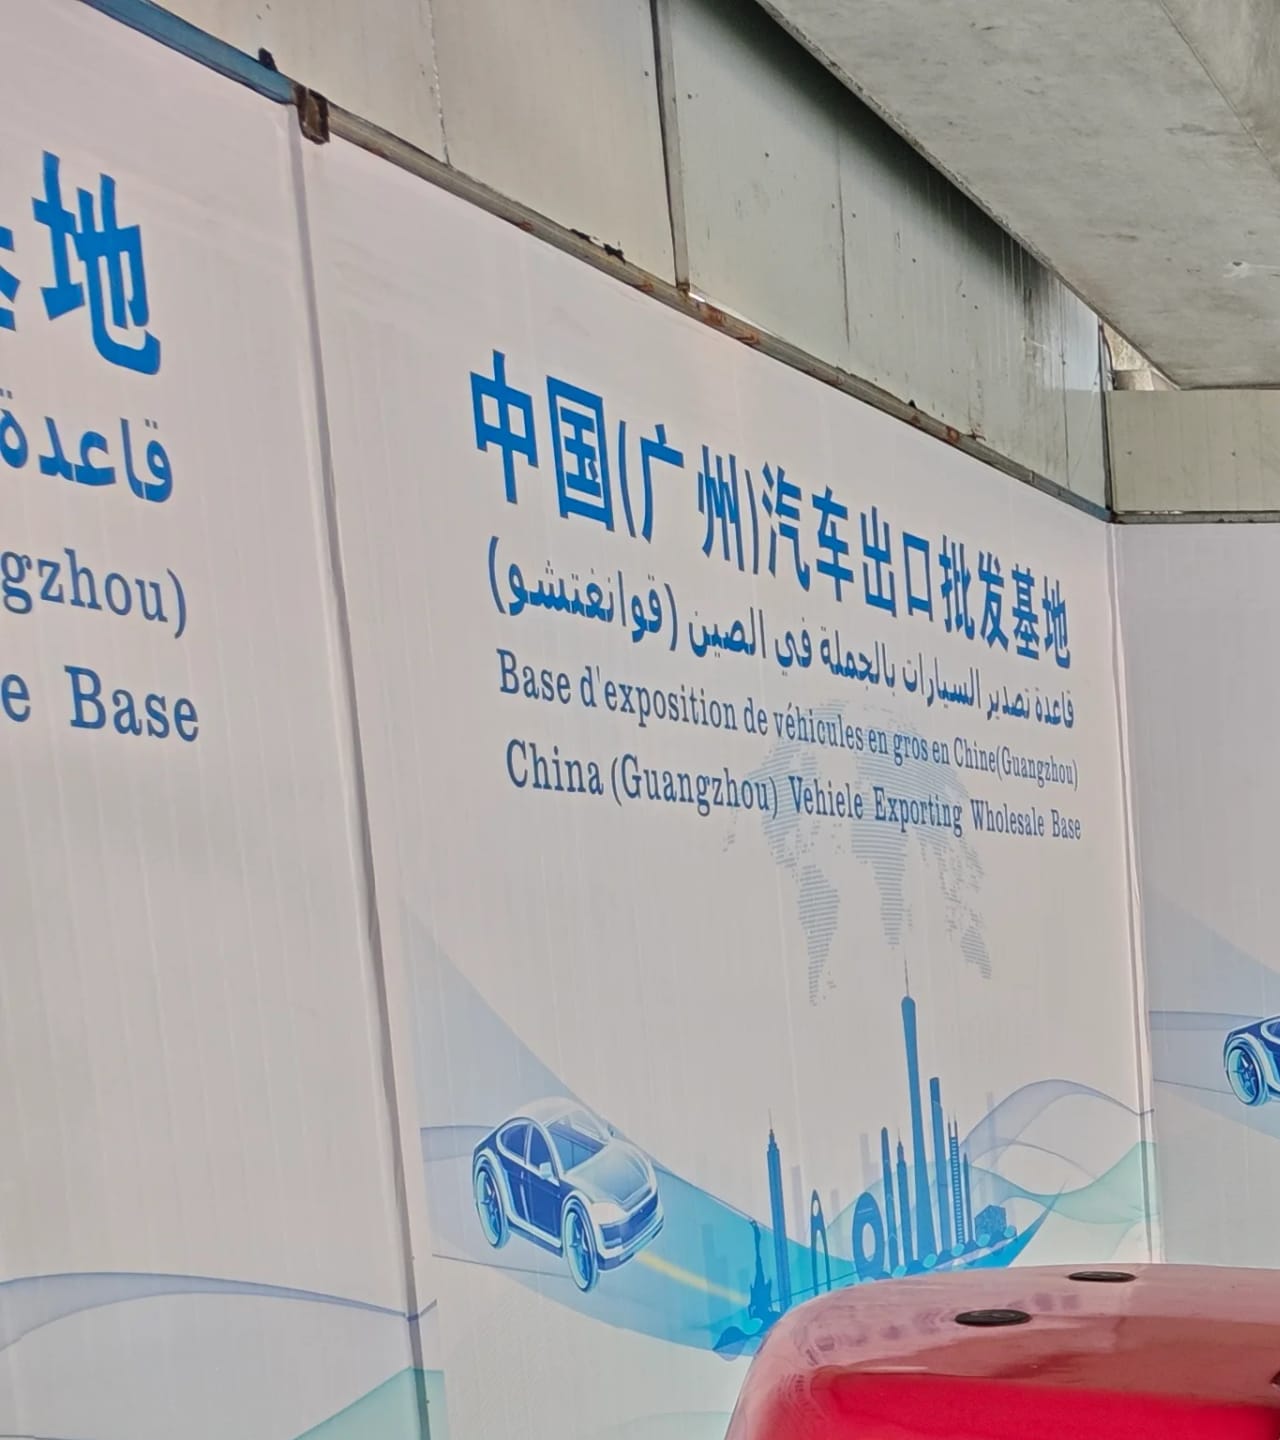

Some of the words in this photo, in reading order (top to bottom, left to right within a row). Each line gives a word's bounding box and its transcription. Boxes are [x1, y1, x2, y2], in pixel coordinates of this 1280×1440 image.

[470, 350, 1071, 669] 中国(广州)汽车出口批发基地
[689, 606, 766, 658] الصين
[820, 626, 895, 696] بالجملة
[64, 664, 199, 742] Base
[496, 647, 571, 704] Base
[580, 665, 738, 727] d'exposition
[744, 697, 768, 736] de
[773, 702, 864, 750] véhicules
[868, 729, 889, 755] en
[893, 733, 928, 766] gros
[932, 744, 950, 765] en
[902, 652, 981, 709] السيارات
[987, 685, 1030, 720] تصدير
[1036, 687, 1074, 729] قاعدة
[506, 738, 604, 795] China
[611, 753, 777, 819] (Guangzhou)
[872, 785, 963, 838] Exporting
[970, 798, 1045, 837] Wholesale
[1050, 808, 1081, 840] Base
